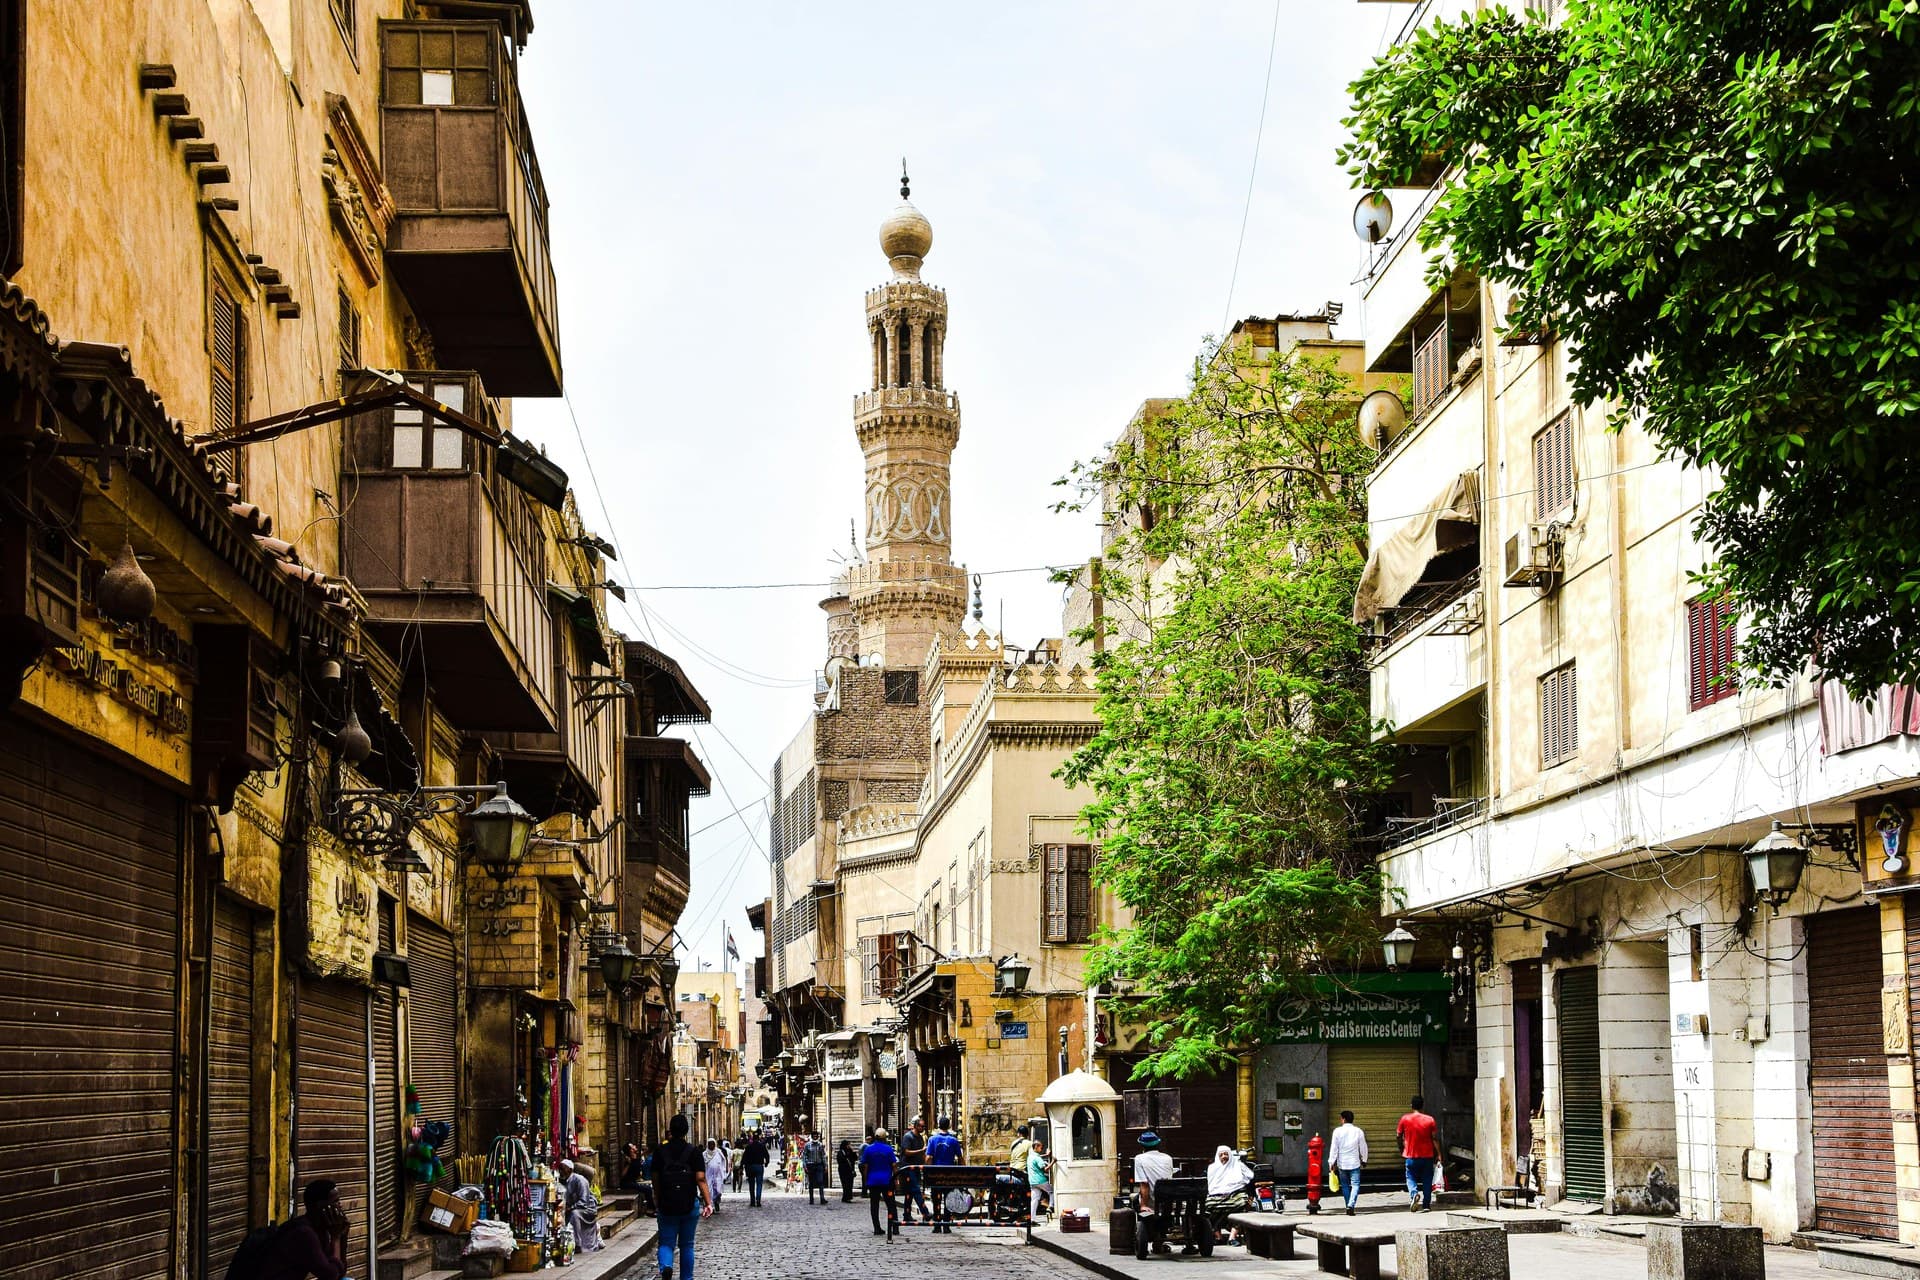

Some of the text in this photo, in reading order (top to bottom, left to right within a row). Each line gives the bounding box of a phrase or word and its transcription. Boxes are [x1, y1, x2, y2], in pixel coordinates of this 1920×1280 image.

[94, 653, 119, 692] And
[126, 670, 160, 716] Gamal
[1360, 998, 1398, 1012] الخدمات
[1397, 998, 1421, 1014] مركز
[1318, 1019, 1423, 1039] Postal Services Center
